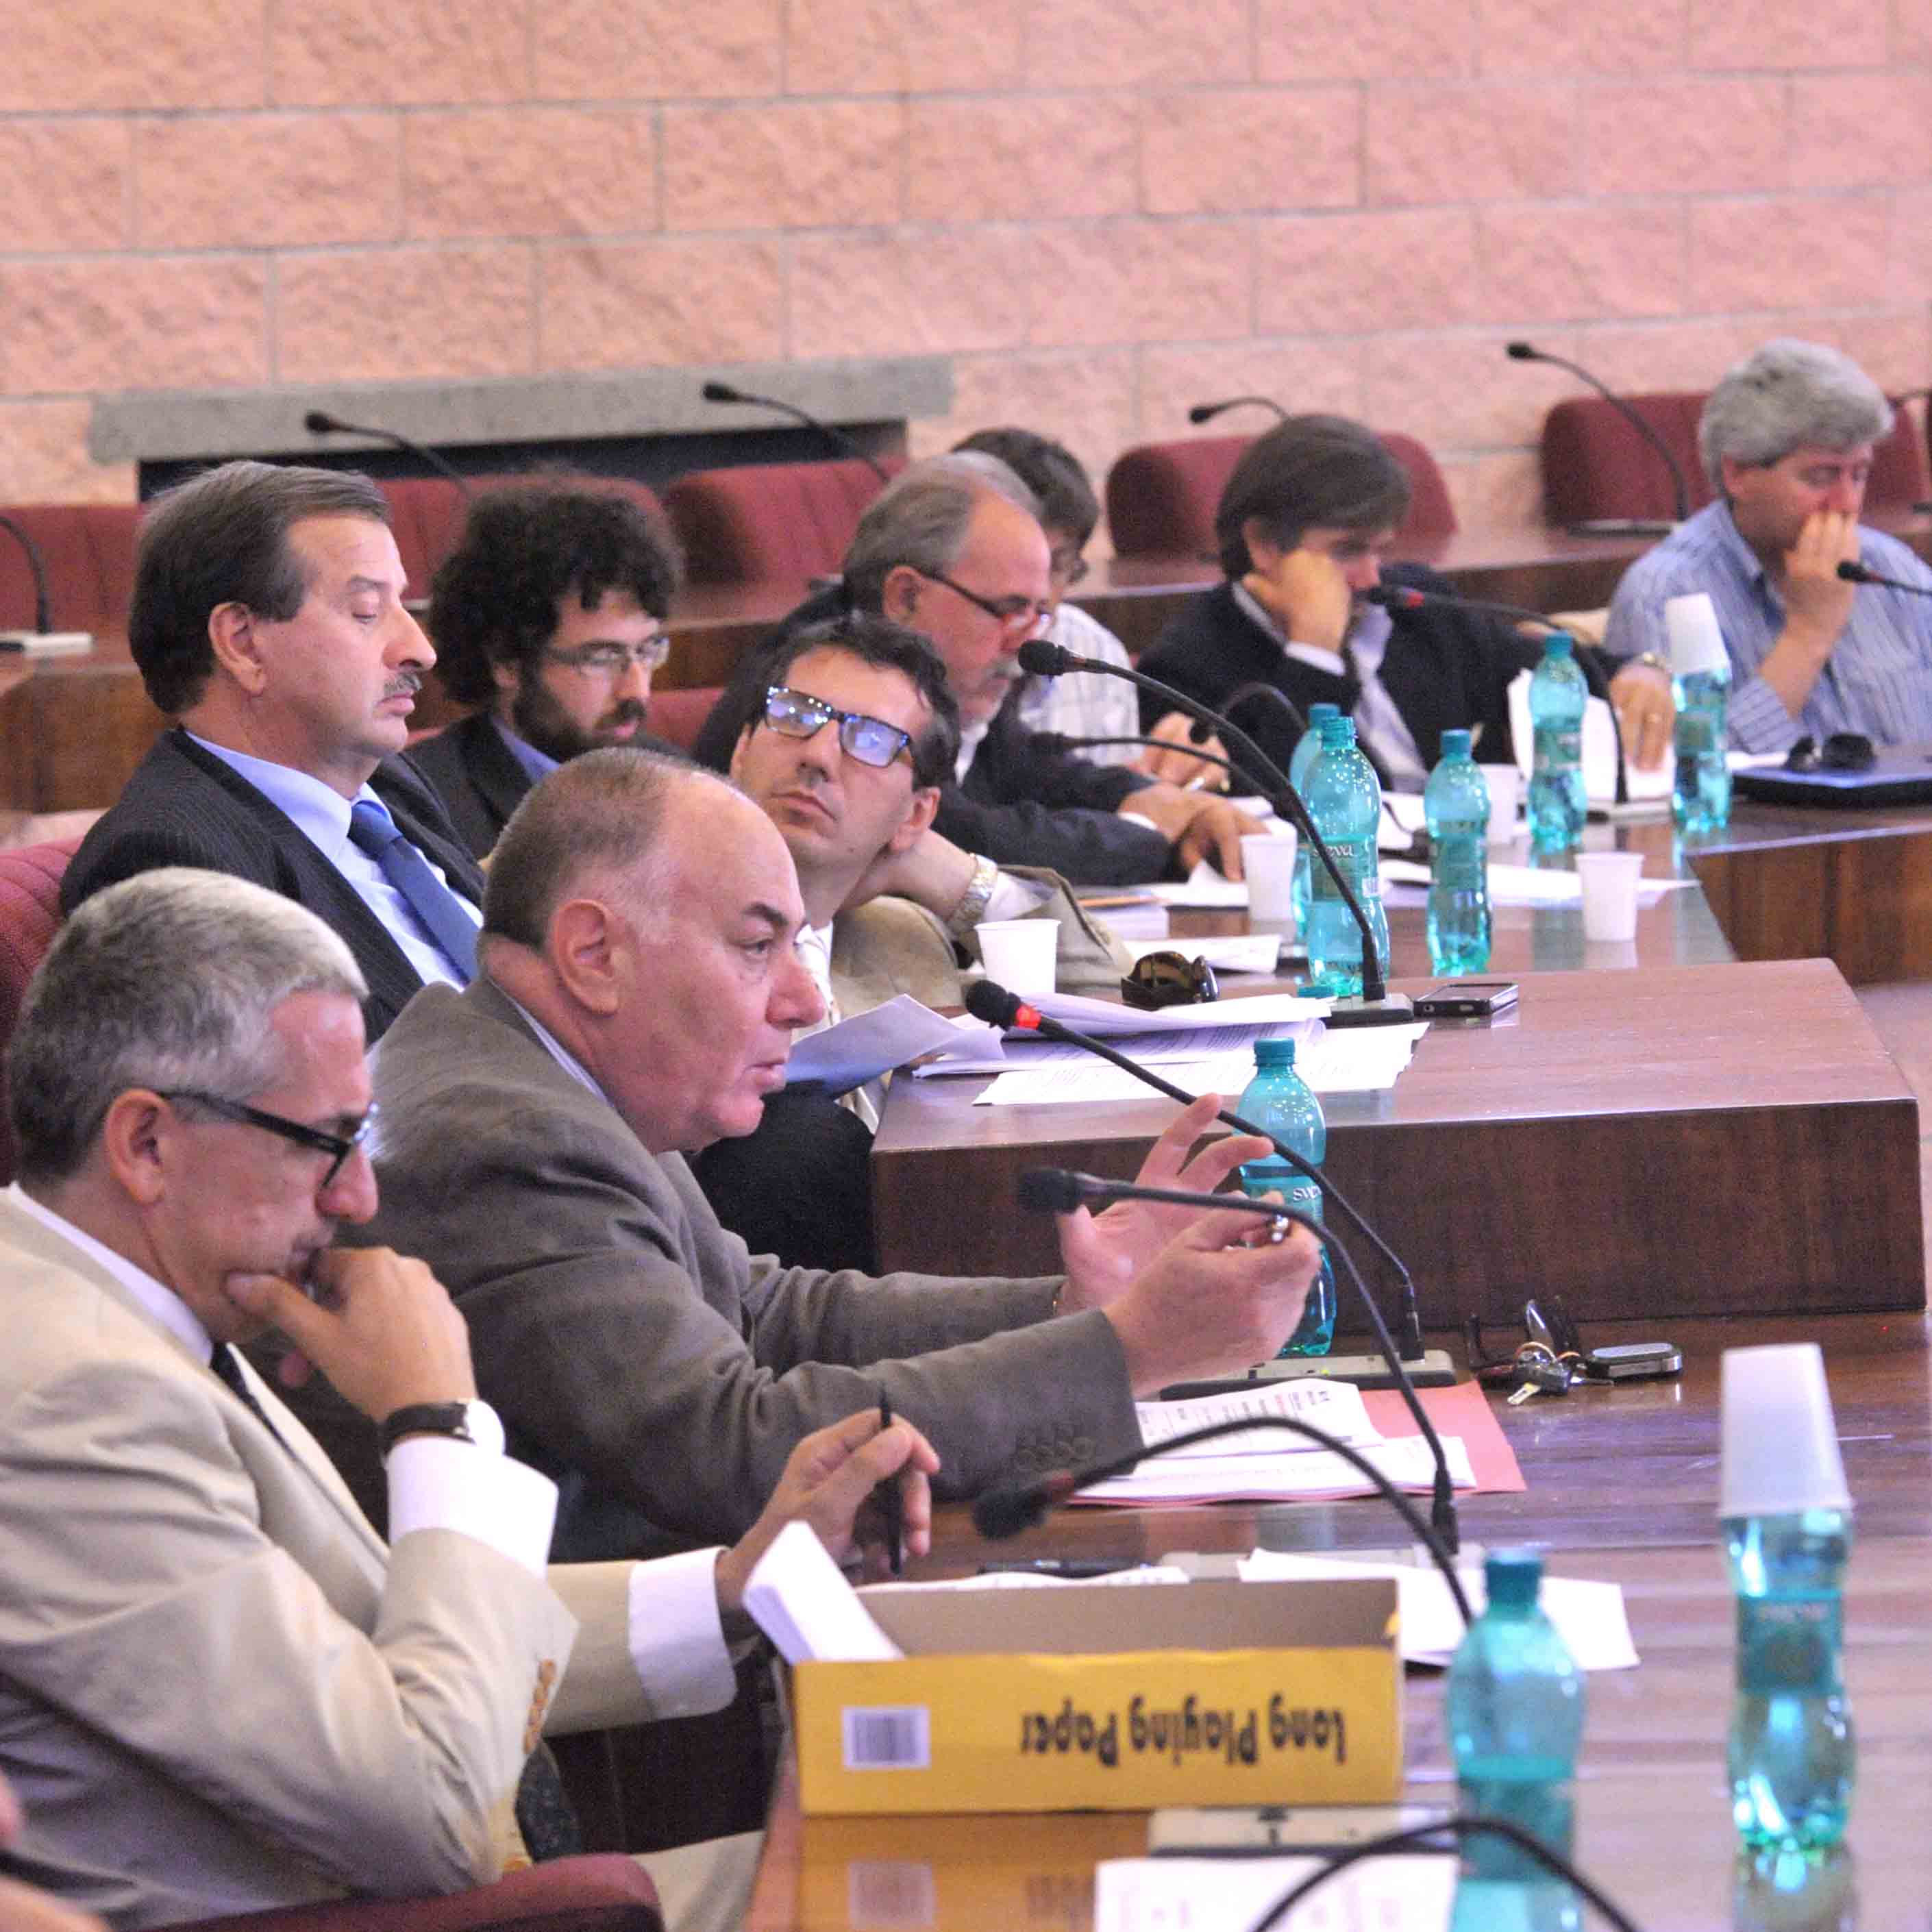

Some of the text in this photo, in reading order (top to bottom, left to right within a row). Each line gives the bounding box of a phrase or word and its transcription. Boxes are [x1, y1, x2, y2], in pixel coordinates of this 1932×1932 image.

[1021, 1692, 1346, 1768] Long Playing Paper
